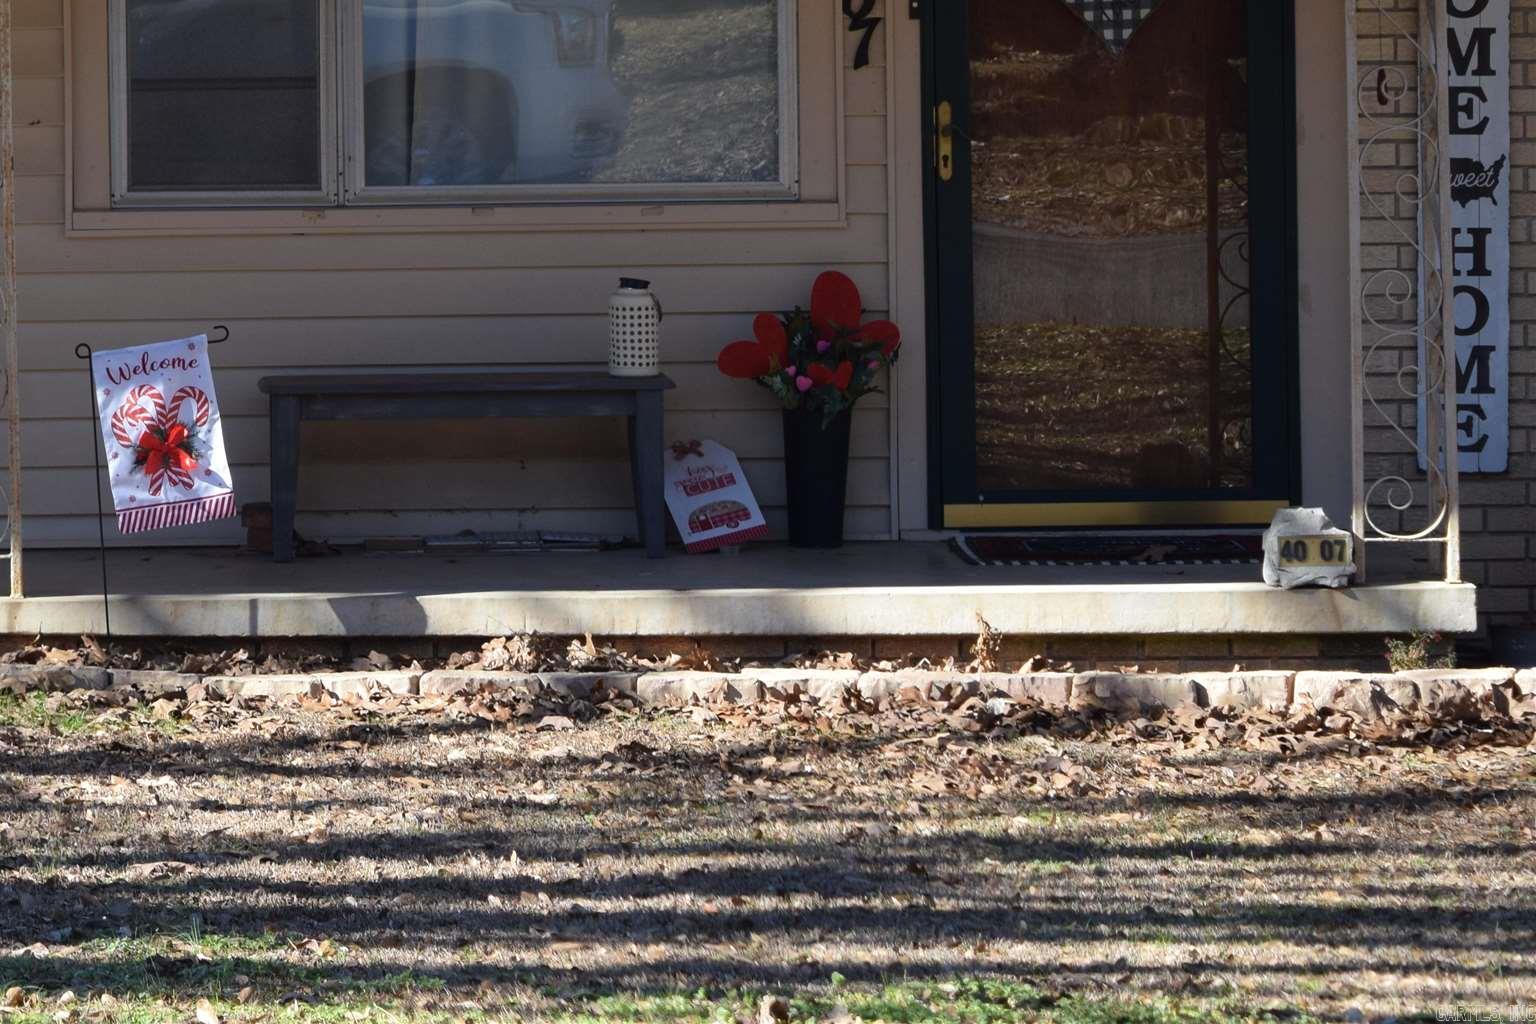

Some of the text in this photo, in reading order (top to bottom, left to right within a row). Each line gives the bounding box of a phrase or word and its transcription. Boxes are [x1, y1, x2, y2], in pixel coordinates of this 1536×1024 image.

[1449, 170, 1495, 188] weet
[1446, 226, 1497, 453] HOME
[106, 351, 198, 385] Welcome
